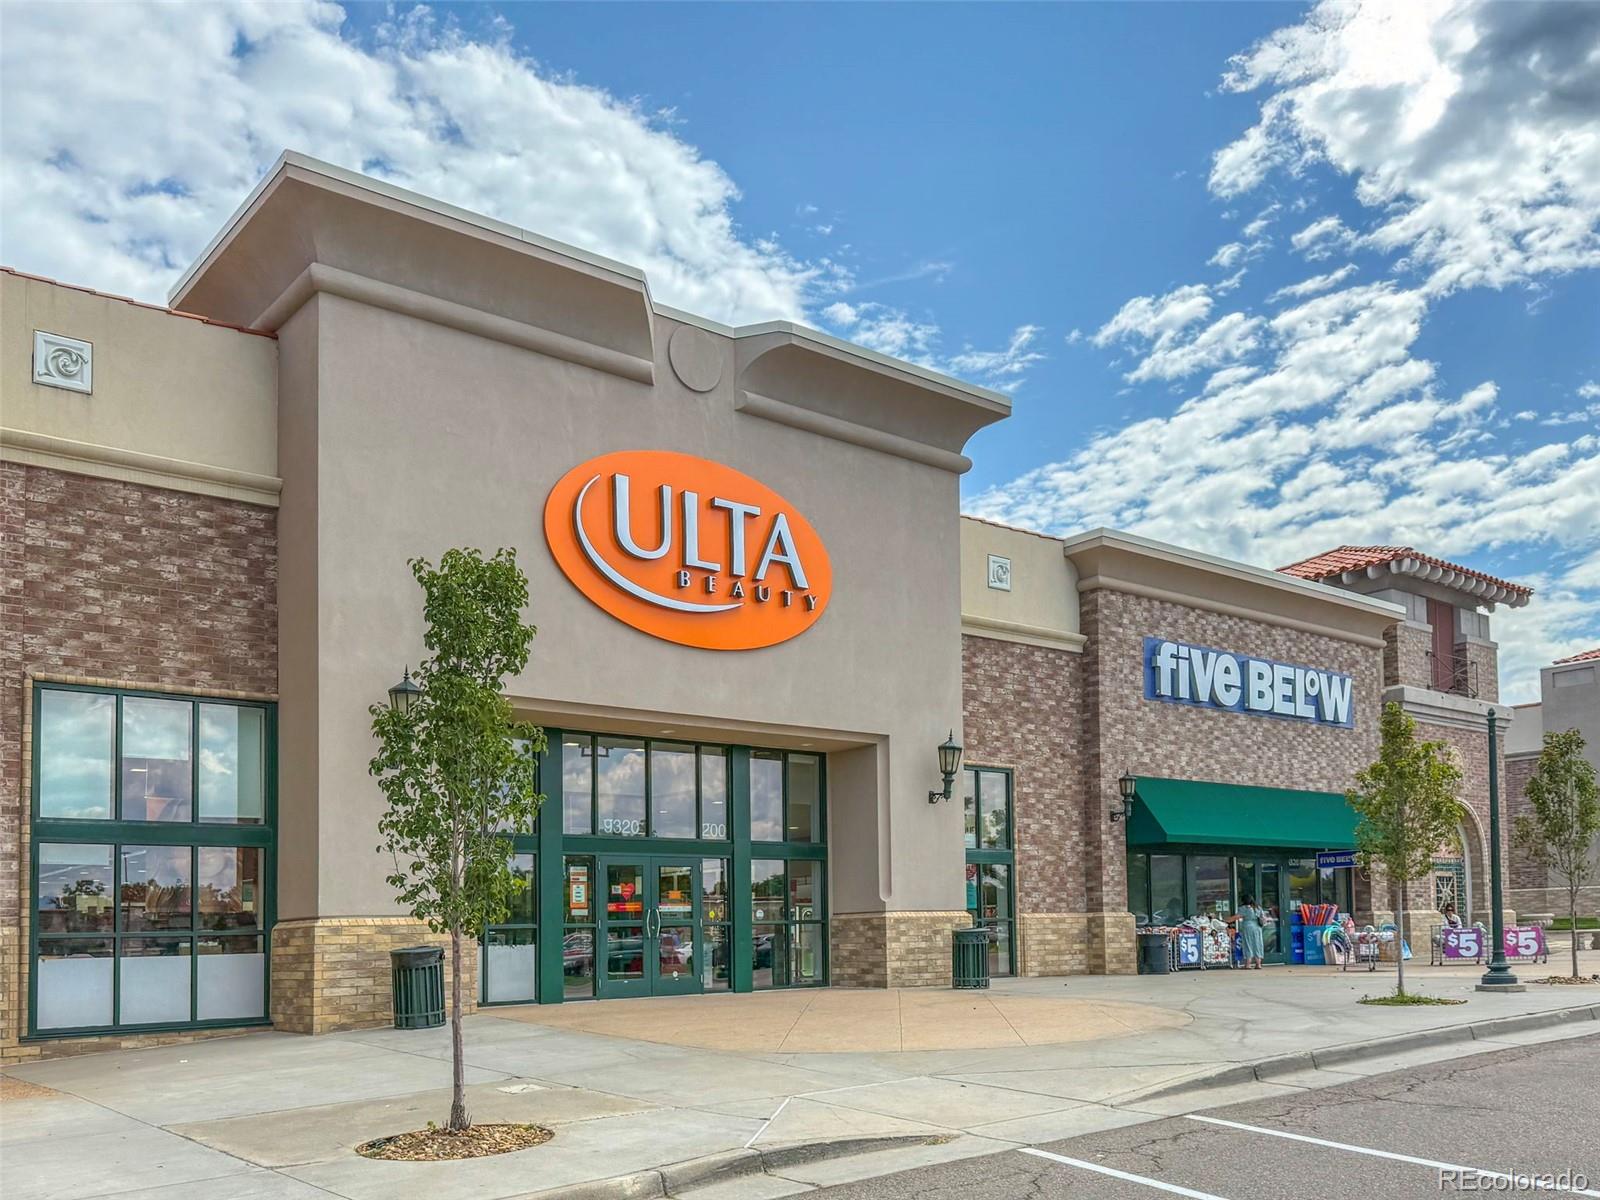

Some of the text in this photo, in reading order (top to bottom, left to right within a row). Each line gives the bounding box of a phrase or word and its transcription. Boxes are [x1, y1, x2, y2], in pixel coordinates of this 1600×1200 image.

[611, 473, 809, 590] ULTA
[676, 569, 817, 611] BEAUTY
[1152, 641, 1353, 723] five BELOW
[603, 818, 640, 834] 9320
[702, 823, 726, 838] 200
[1180, 937, 1199, 962] $5
[1447, 932, 1479, 957] $5
[1506, 931, 1539, 956] $5
